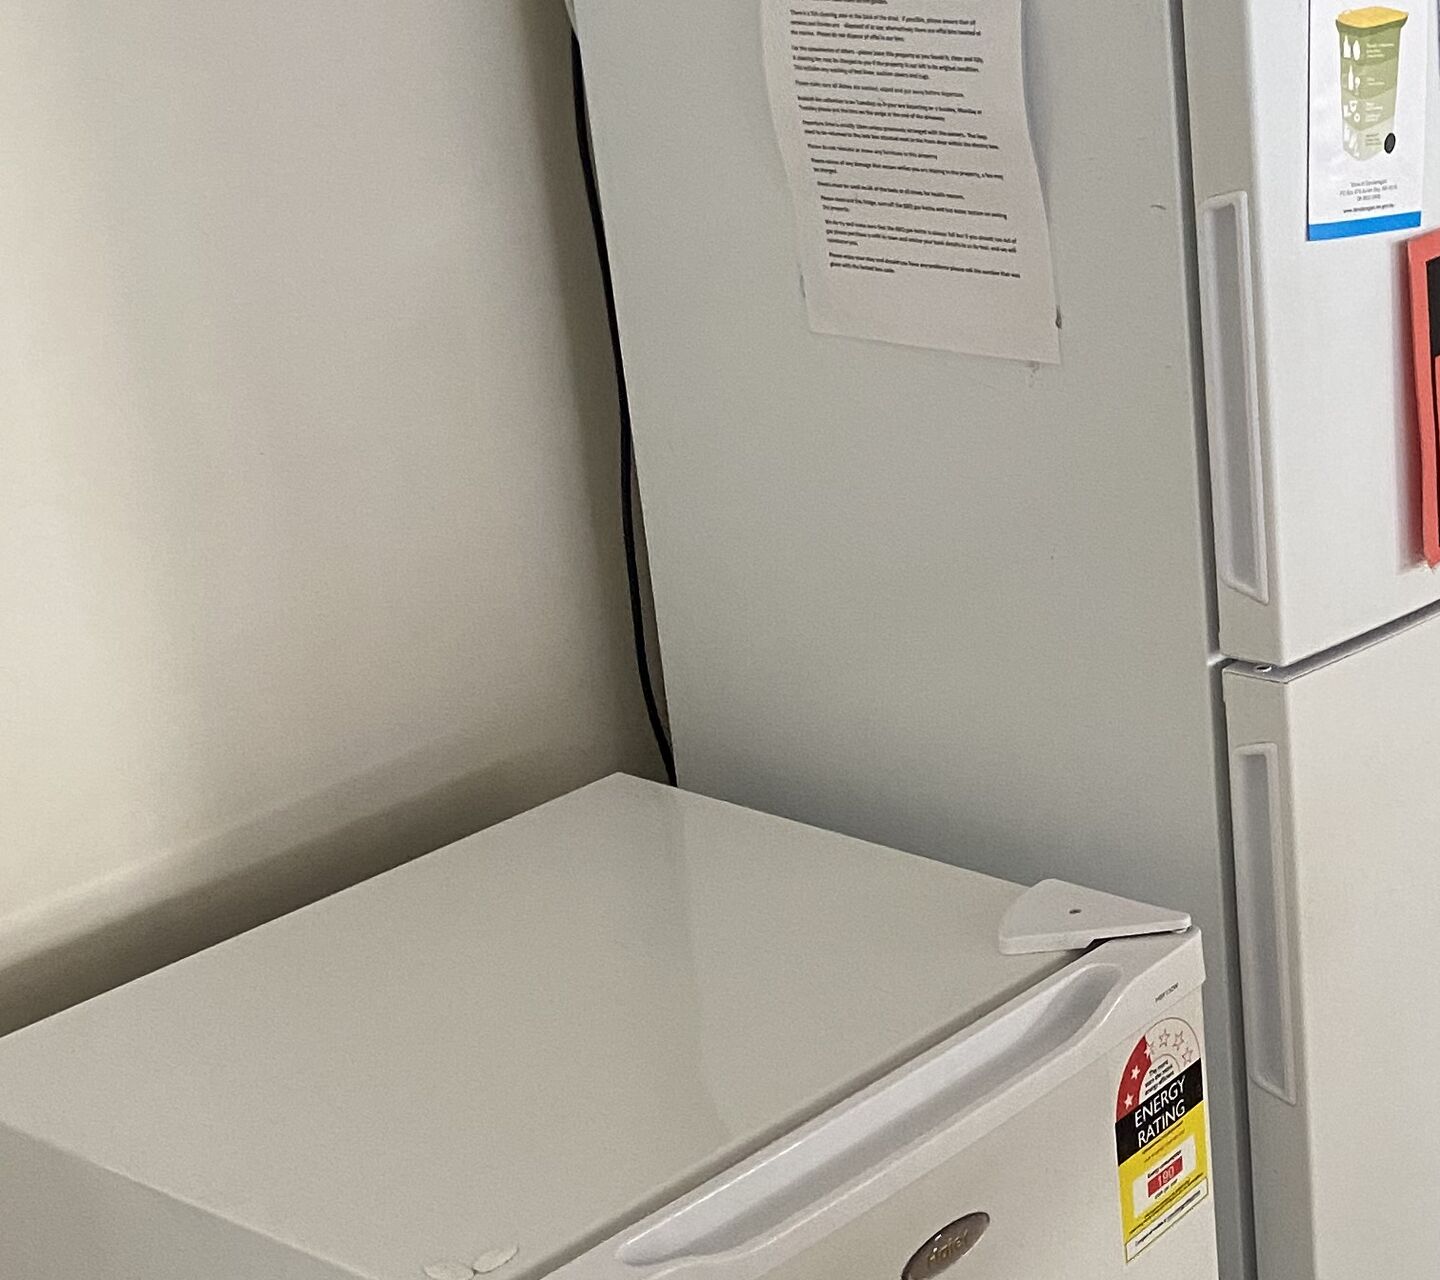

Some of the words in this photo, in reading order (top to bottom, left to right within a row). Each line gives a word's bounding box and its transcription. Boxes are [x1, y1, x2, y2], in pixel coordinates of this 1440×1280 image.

[1134, 1074, 1186, 1129] ENERGY
[1138, 1098, 1186, 1148] RATING
[1157, 1166, 1175, 1186] 190
